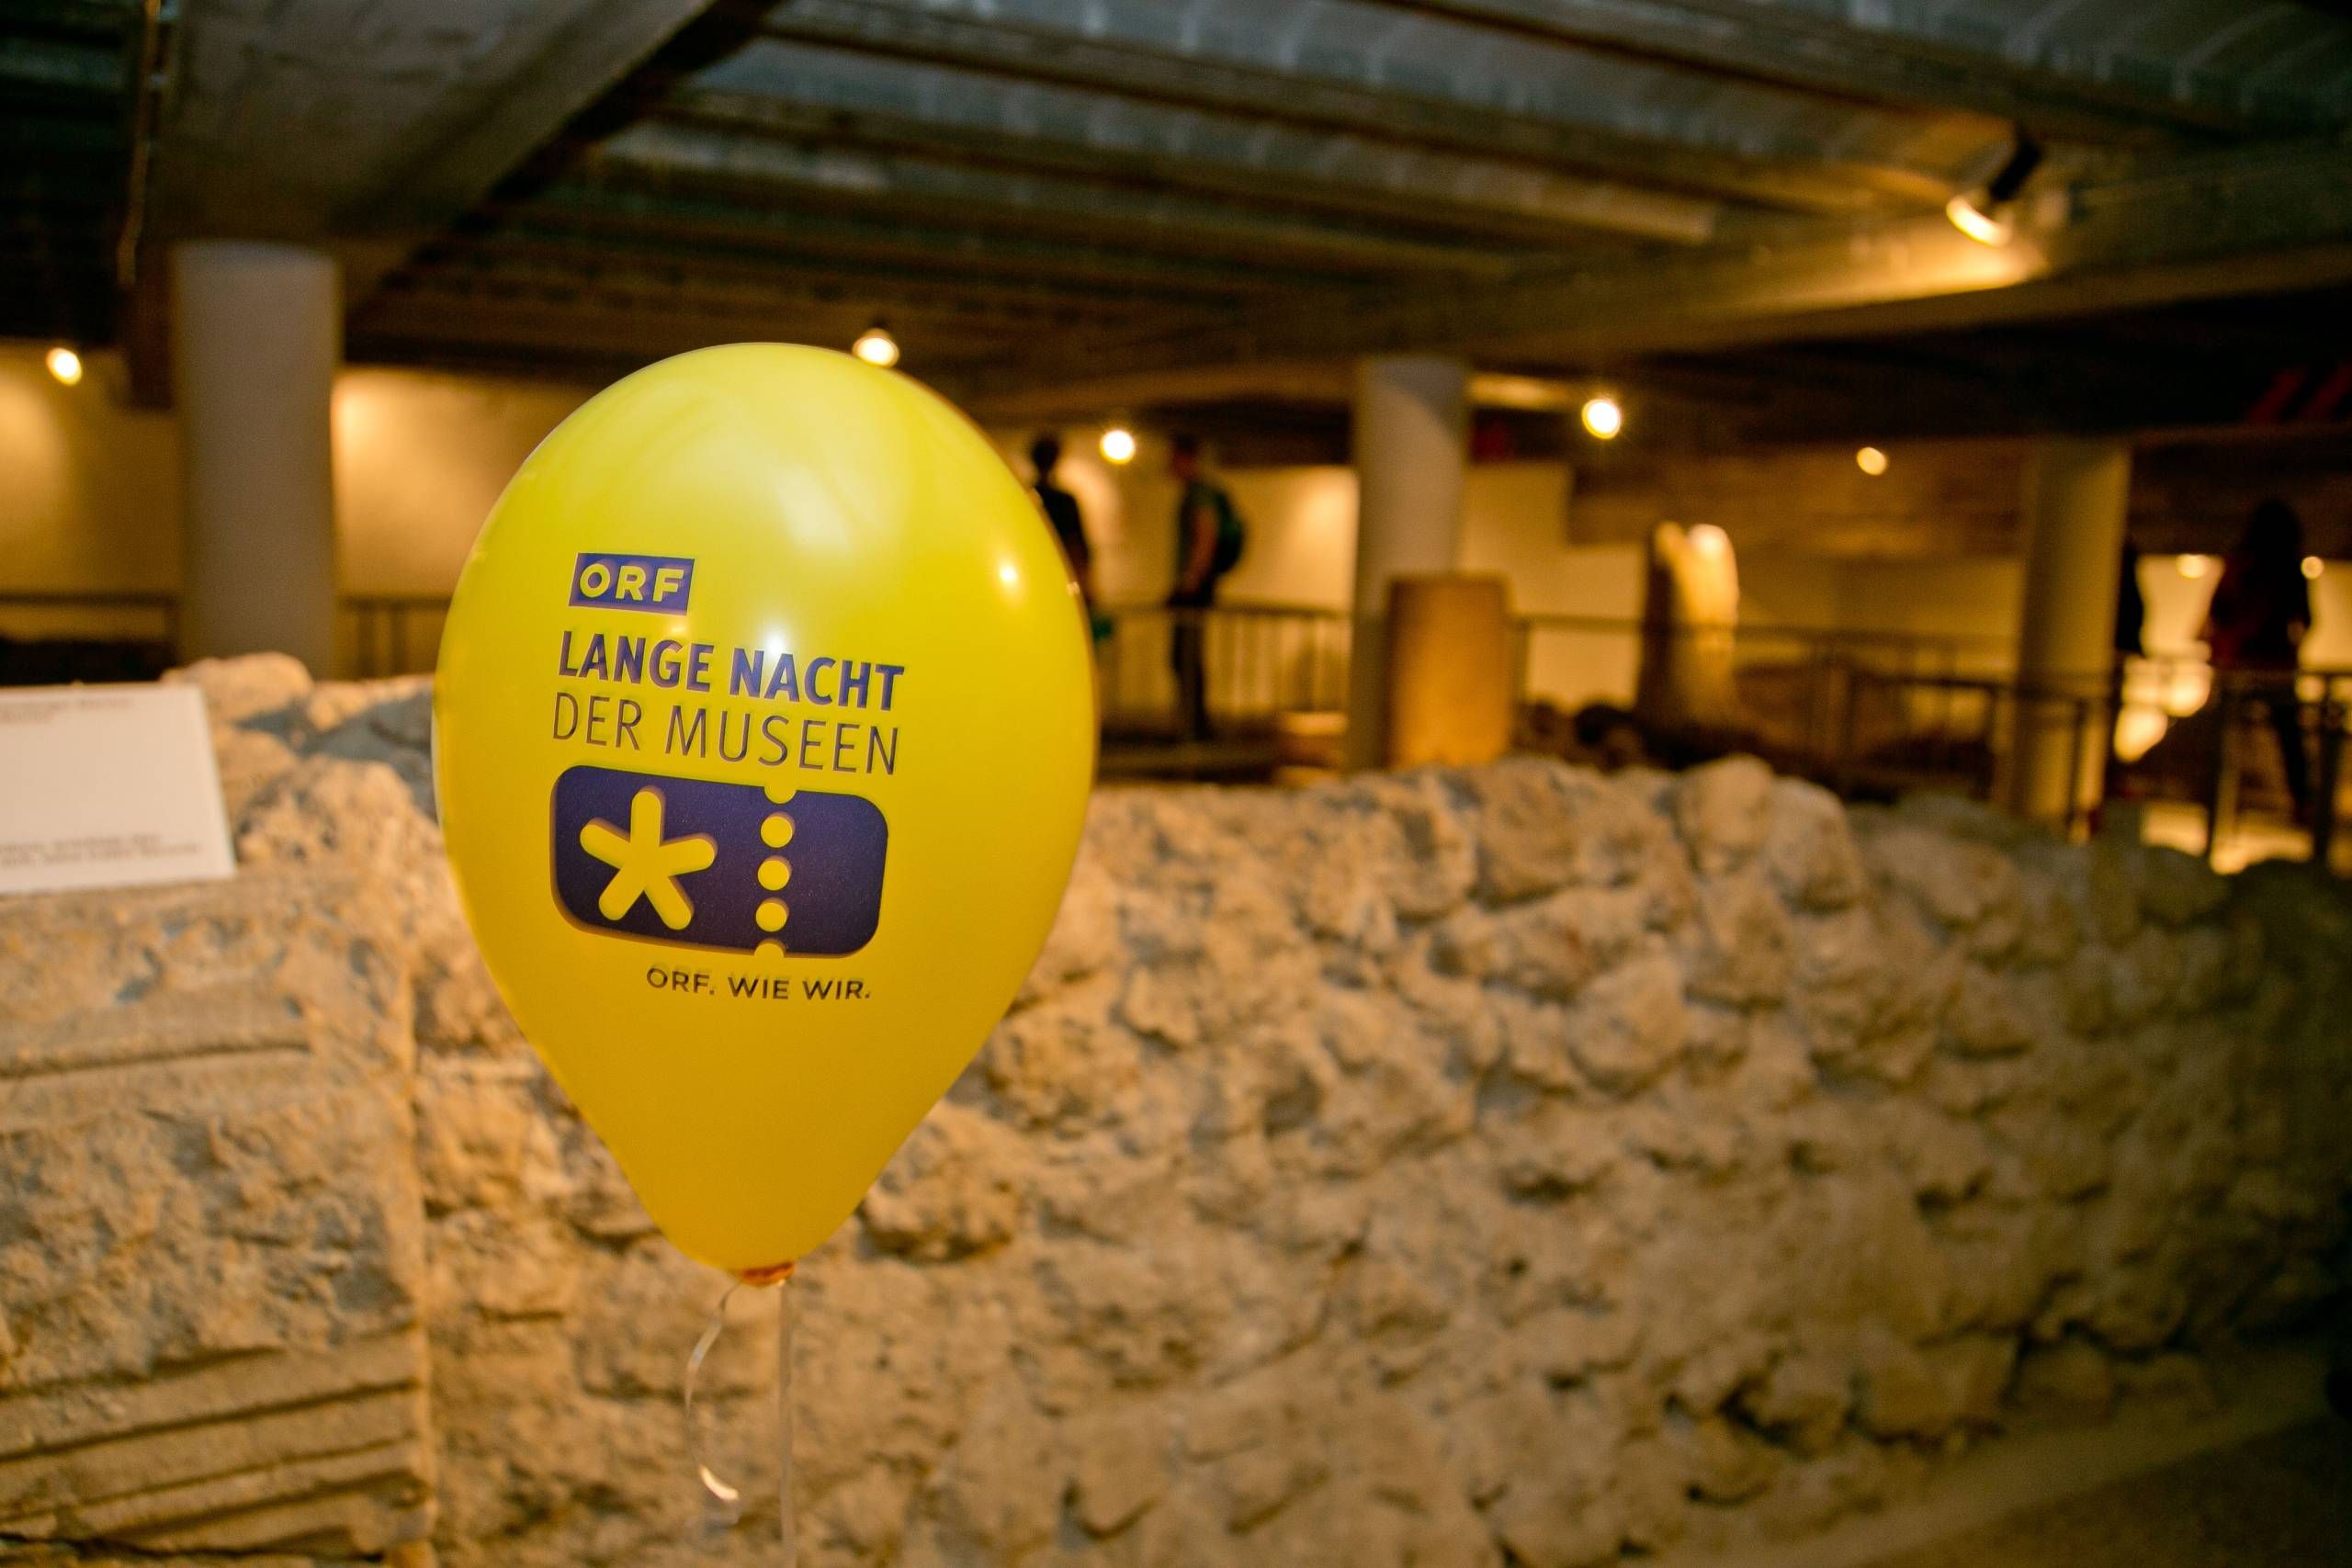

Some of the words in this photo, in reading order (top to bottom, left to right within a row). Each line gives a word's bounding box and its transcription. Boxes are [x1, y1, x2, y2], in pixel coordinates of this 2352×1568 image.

[579, 563, 684, 604] ORF
[559, 631, 715, 693] LANGE
[729, 648, 905, 712] NACHT
[552, 692, 642, 750] DER
[664, 705, 899, 775] MUSEEN
[646, 967, 715, 996] ORF.
[728, 976, 790, 1000] WIE
[802, 979, 872, 1001] WIR.
